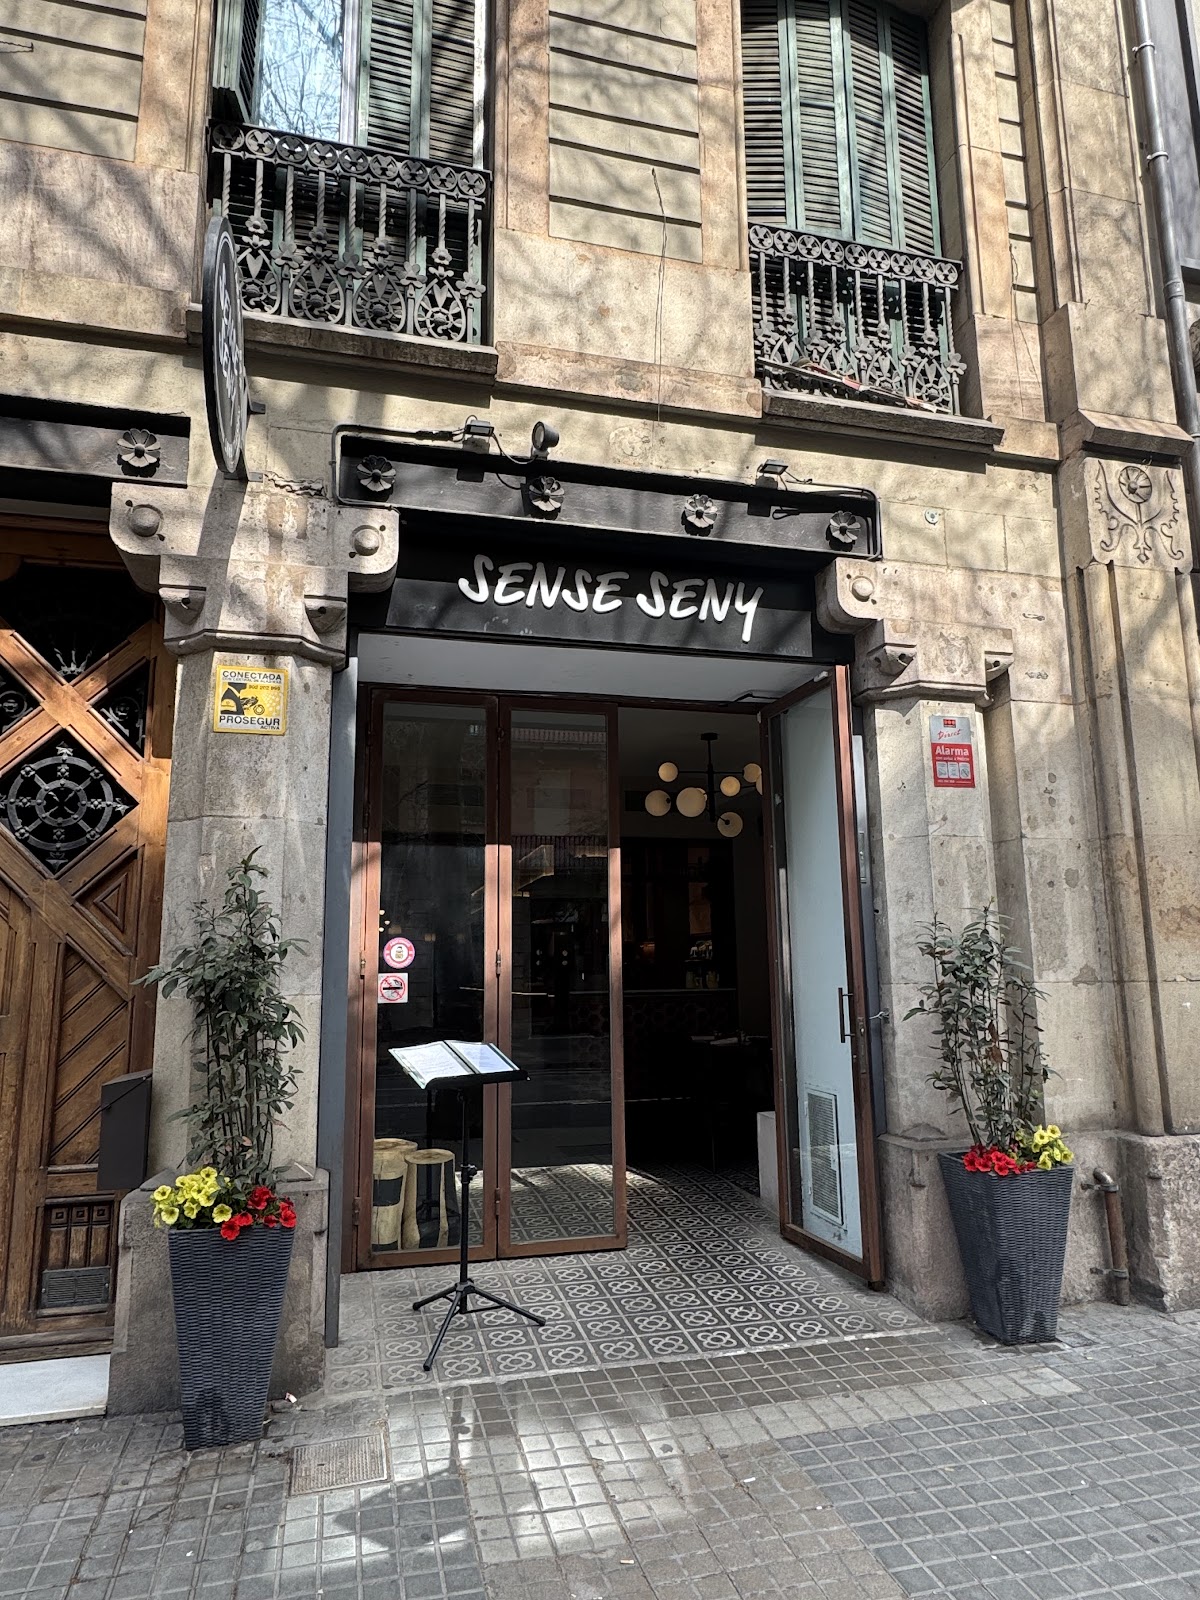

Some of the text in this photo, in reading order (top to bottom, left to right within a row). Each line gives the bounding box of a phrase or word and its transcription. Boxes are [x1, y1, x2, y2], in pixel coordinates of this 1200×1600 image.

[458, 554, 764, 643] SENSE SENY
[223, 671, 281, 680] CONECTADA
[219, 715, 280, 726] PROSEGUR
[936, 745, 969, 755] Alarma
